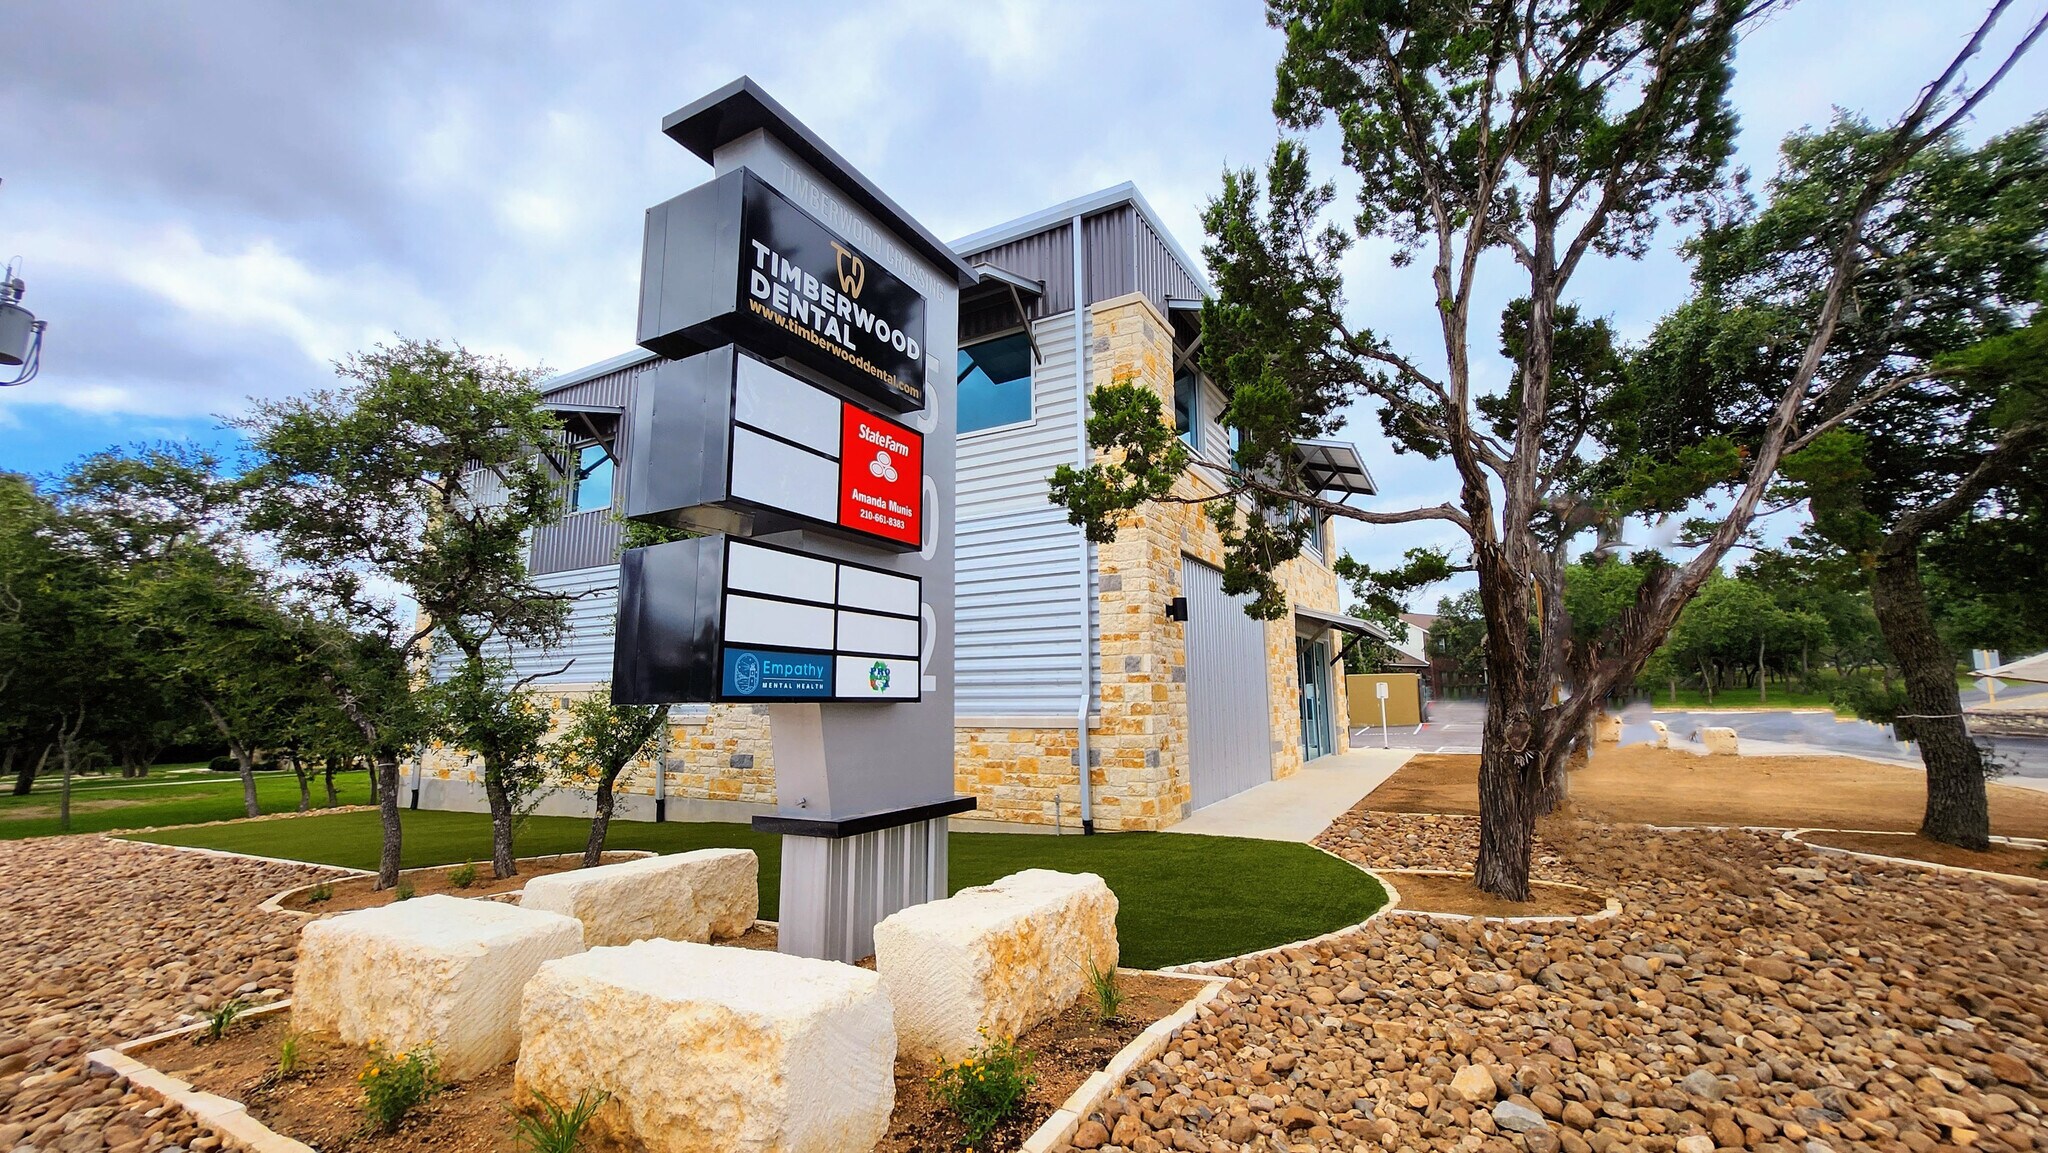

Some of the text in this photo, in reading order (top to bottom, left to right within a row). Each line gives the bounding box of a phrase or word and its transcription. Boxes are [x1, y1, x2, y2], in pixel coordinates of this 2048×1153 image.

[780, 160, 945, 302] TIMBERWOOD CROSSING
[750, 268, 857, 351] DENTAL
[751, 238, 920, 360] TIMBERWOOD
[749, 298, 920, 399] www.timberwooddental.com
[851, 488, 913, 518] Amanda Munis
[859, 508, 905, 530] 210-661-8383
[762, 682, 792, 690] MENTAL
[763, 660, 824, 679] Empathy
